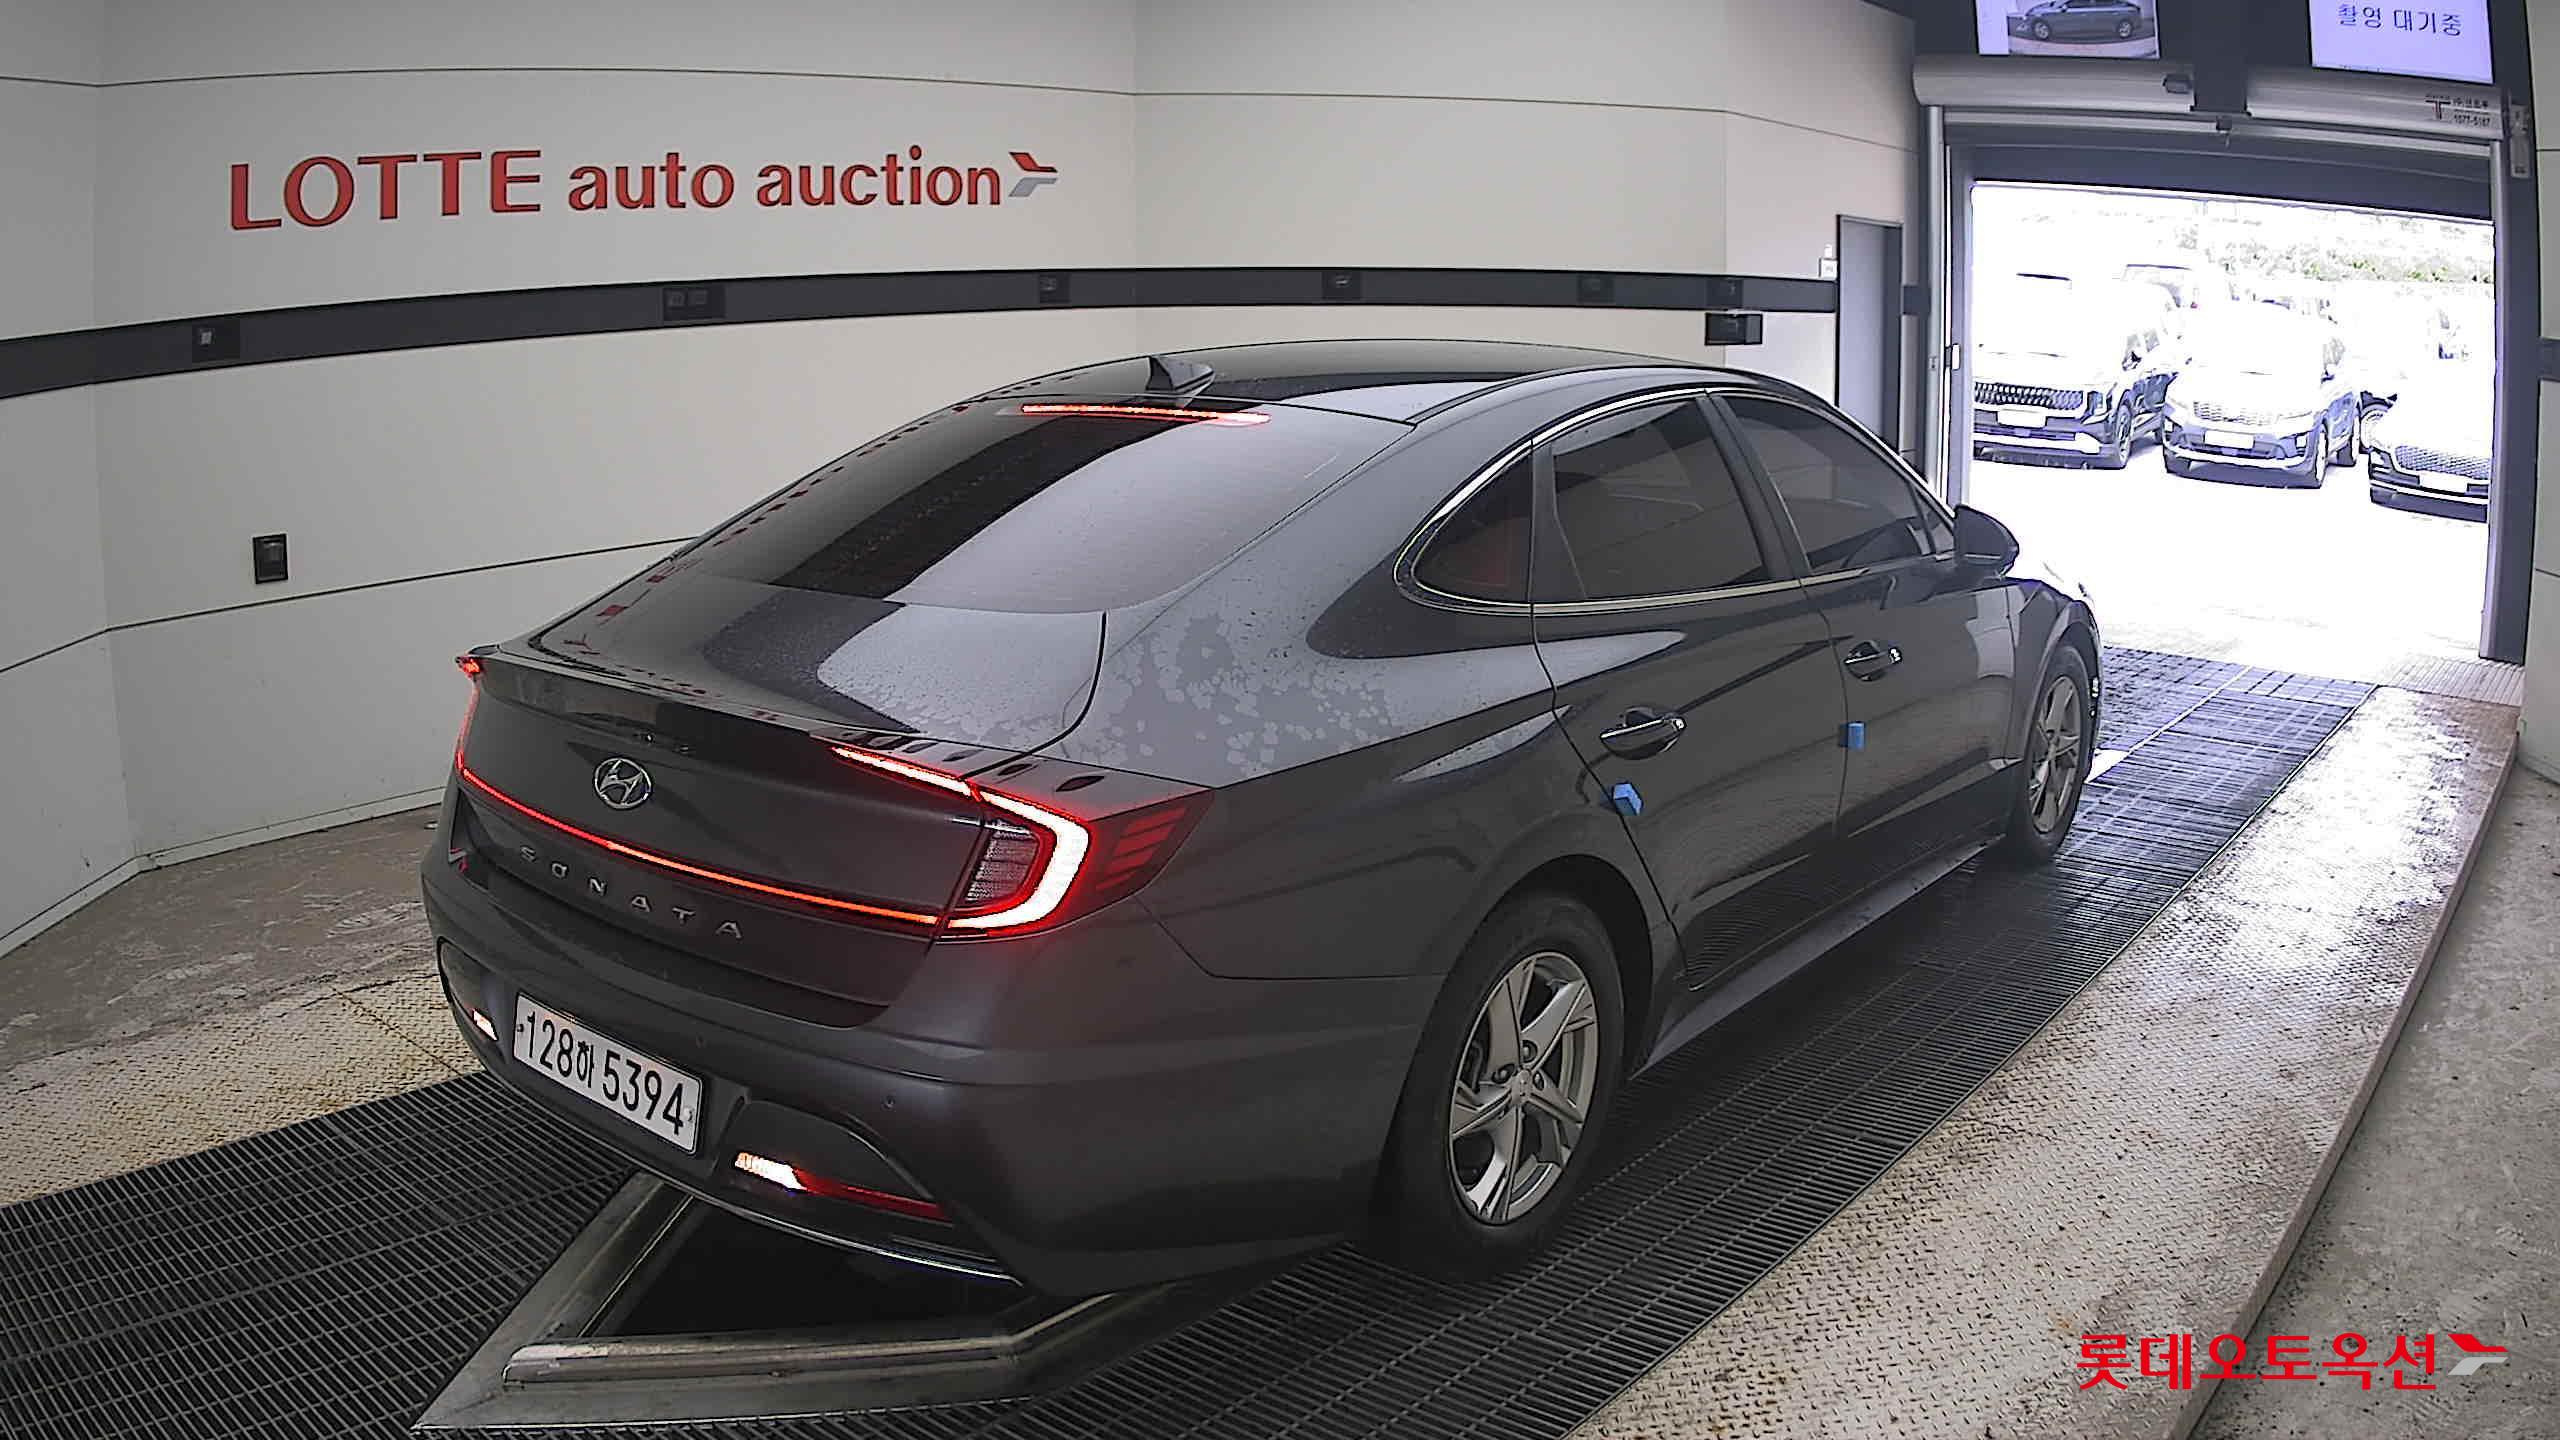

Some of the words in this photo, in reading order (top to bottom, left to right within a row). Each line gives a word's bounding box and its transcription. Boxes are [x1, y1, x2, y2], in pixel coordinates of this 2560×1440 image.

[2338, 3, 2382, 29] 촬영
[2393, 9, 2462, 36] 대기중
[231, 150, 541, 230] LOTTE
[568, 152, 734, 210] auto
[756, 145, 1001, 206] auction
[519, 845, 742, 939] SONATA
[527, 1011, 595, 1089] 128하
[602, 1049, 684, 1136] 5394
